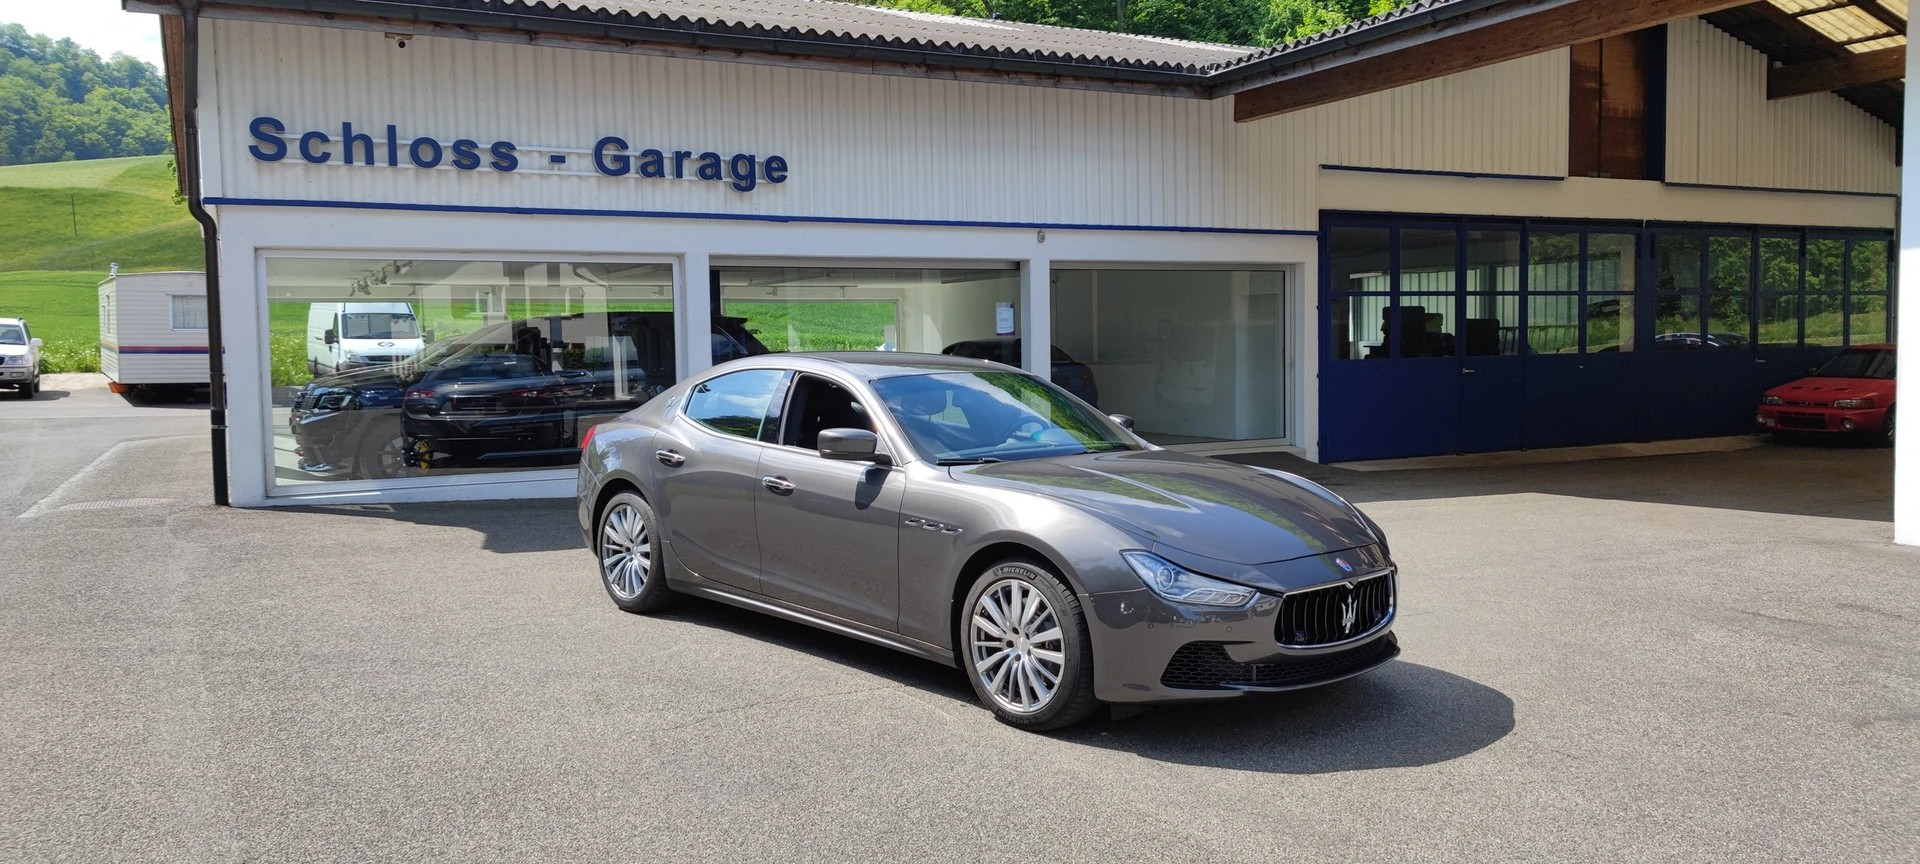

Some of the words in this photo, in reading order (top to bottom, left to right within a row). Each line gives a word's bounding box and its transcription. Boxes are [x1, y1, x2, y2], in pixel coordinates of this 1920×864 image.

[247, 115, 518, 172] Schloss
[593, 135, 789, 192] Garage
[1003, 566, 1036, 580] MICHELIN
